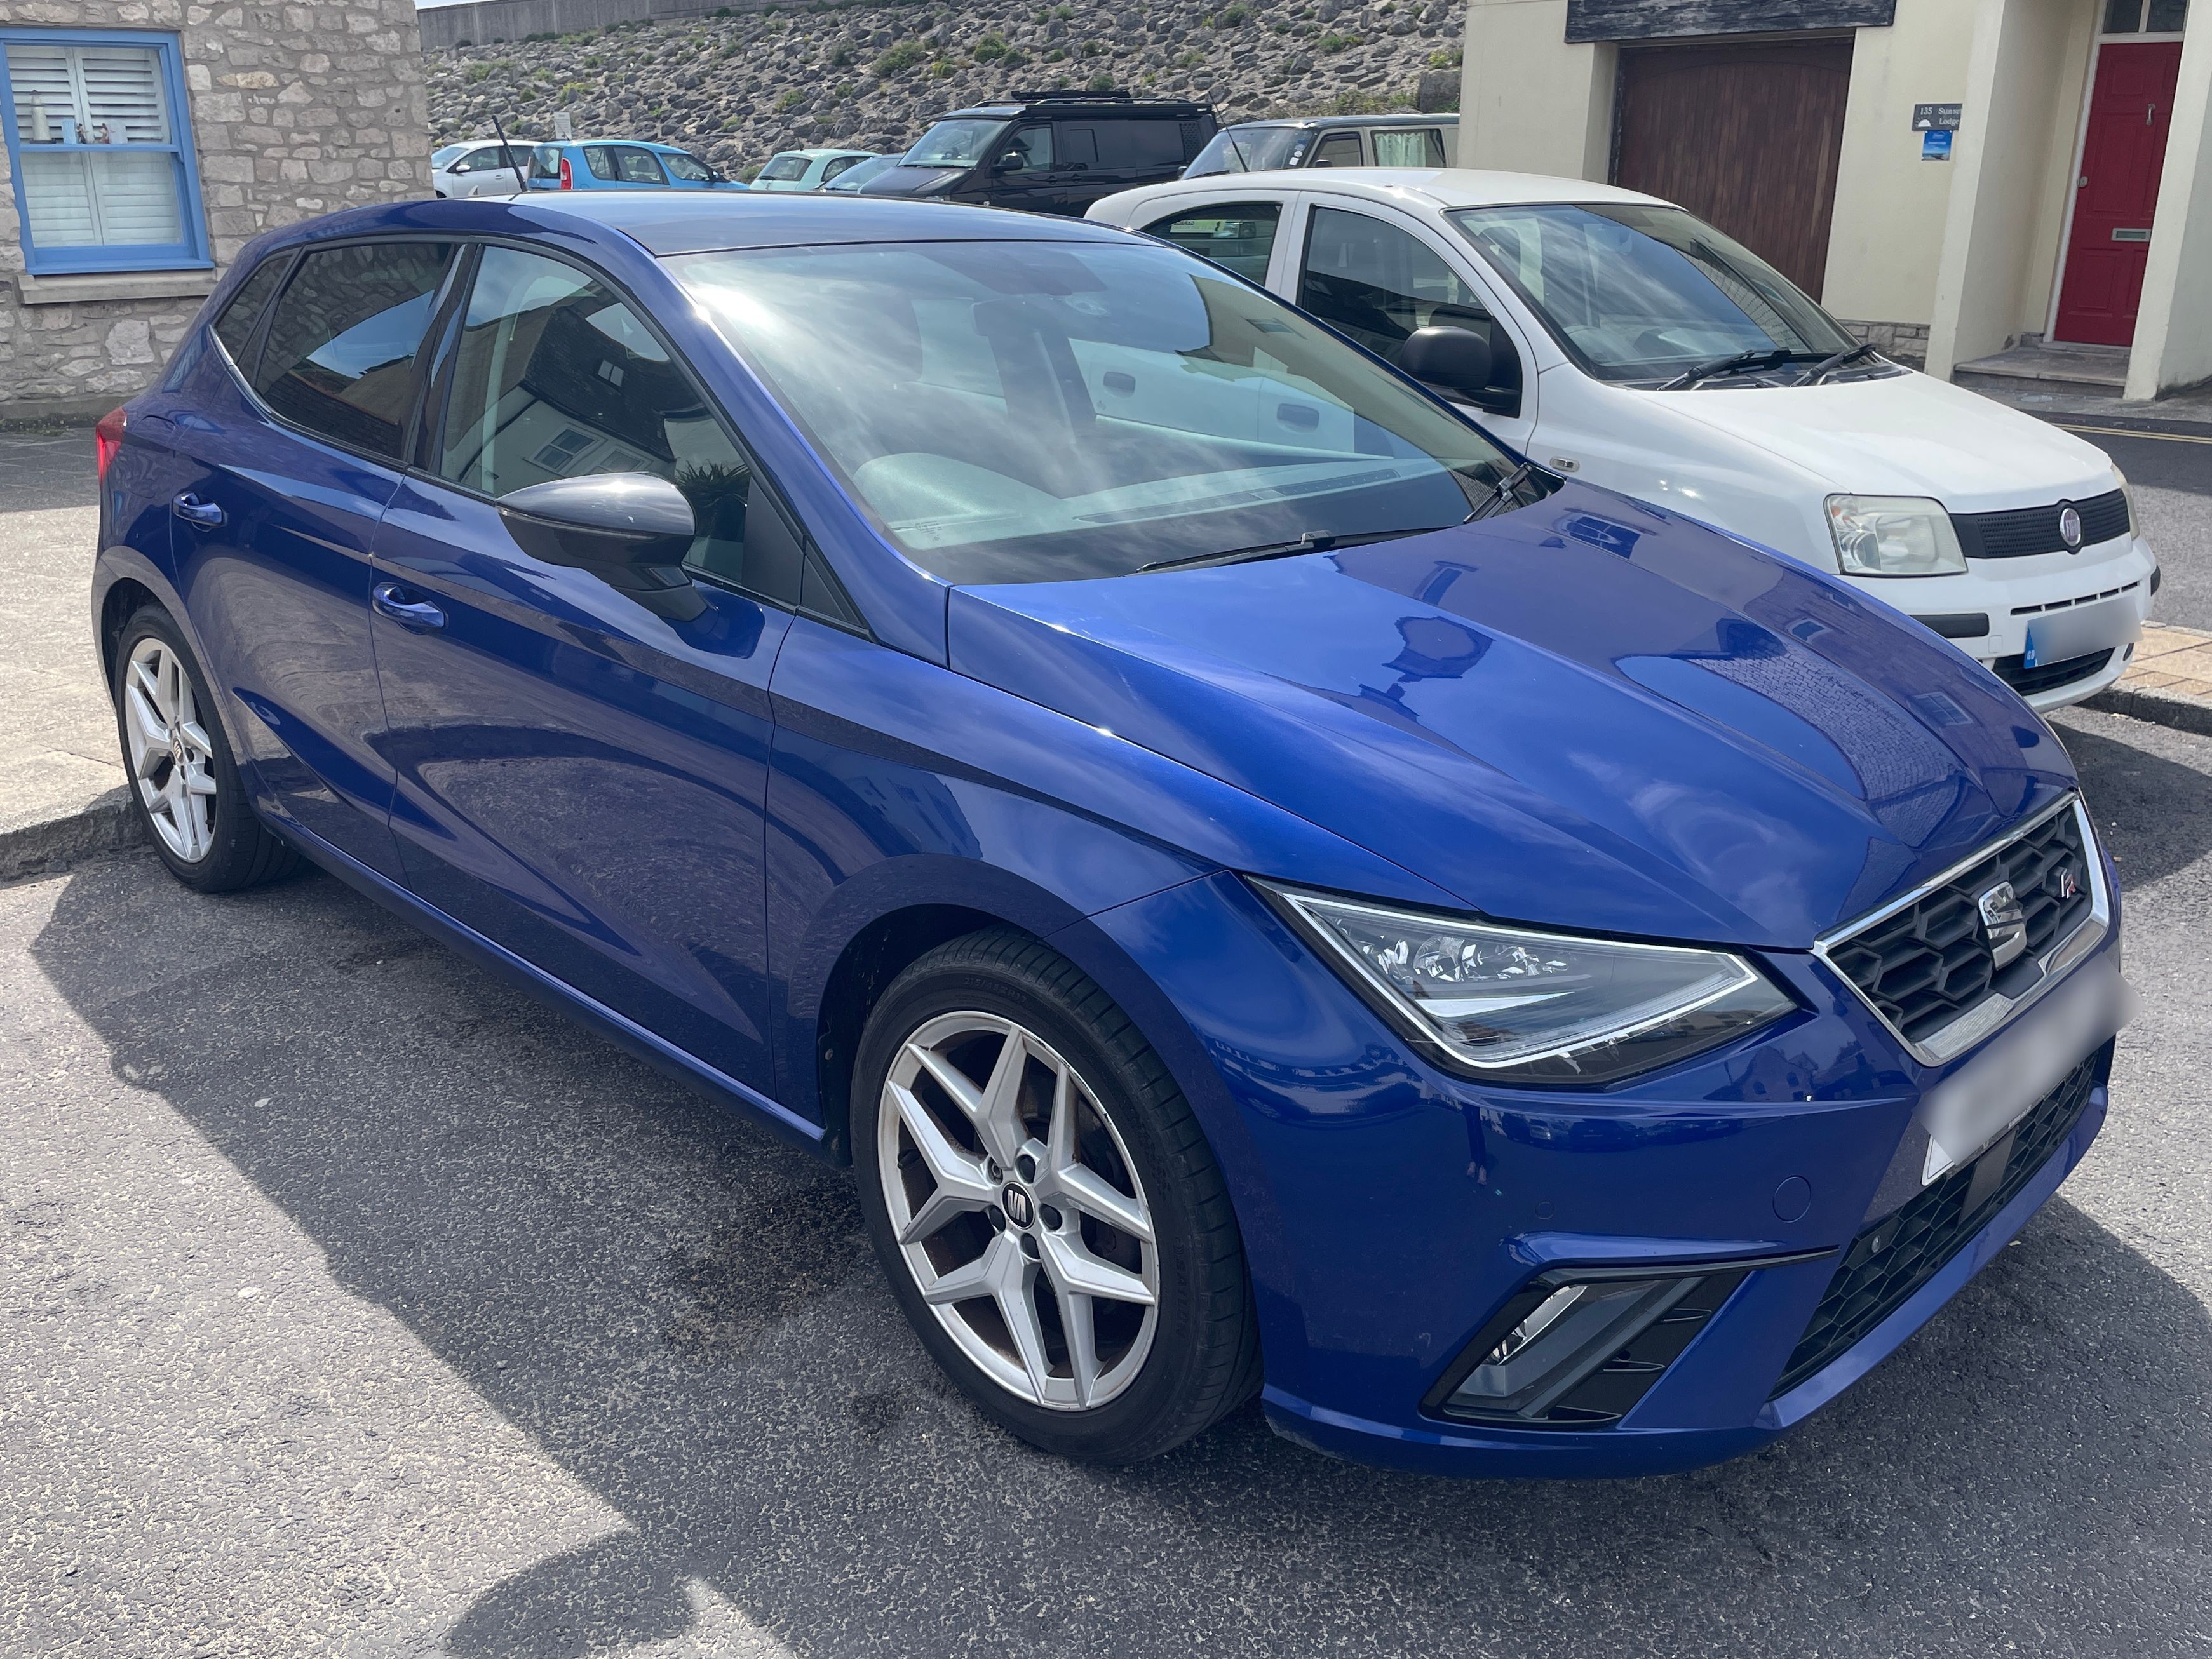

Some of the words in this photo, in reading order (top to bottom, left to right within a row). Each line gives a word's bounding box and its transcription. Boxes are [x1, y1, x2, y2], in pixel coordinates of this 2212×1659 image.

[1920, 107, 1932, 115] 135
[1938, 107, 1960, 115] Sunse
[1939, 118, 1959, 126] Lodge
